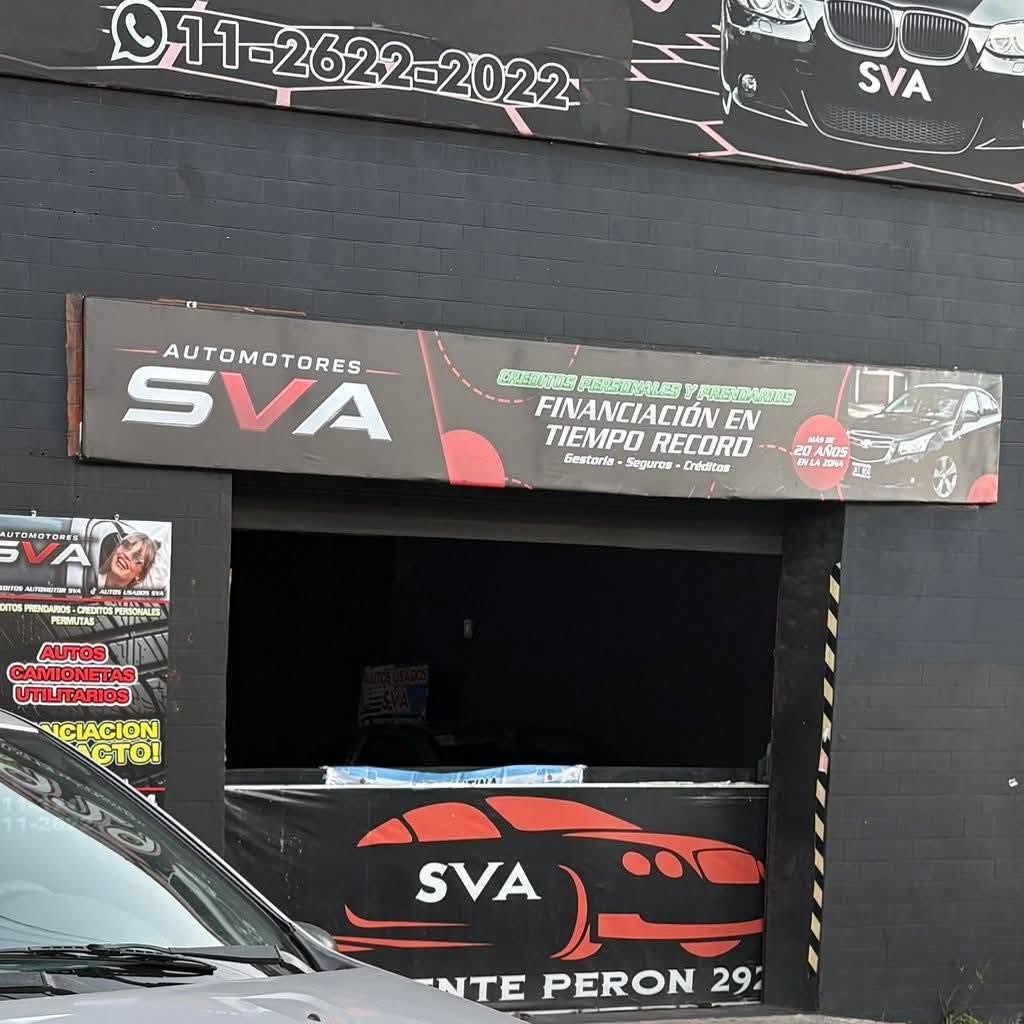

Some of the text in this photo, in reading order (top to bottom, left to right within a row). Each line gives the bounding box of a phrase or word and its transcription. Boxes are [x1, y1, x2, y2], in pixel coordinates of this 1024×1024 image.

[177, 16, 570, 111] 11-2622-2022
[858, 60, 932, 102] SVA
[162, 343, 362, 376] AUTOMOTORES
[121, 365, 393, 443] SVA
[534, 395, 761, 430] FINANCIACIÓN EN
[545, 424, 753, 457] TIEMPO RECORD
[794, 443, 848, 458] 20 AÑOS
[625, 457, 672, 471] Seguros
[683, 460, 730, 472] Créditos
[0, 531, 79, 541] AUTOMOTORES
[24, 604, 71, 615] PRENDARIOS
[77, 606, 114, 616] CREDITOS
[115, 608, 161, 617] PERSONALES
[51, 616, 95, 626] PERMUTAS
[37, 643, 109, 663] AUTOS
[8, 664, 138, 684] CAMIONETAS
[13, 685, 132, 705] UTILITARIOS
[416, 862, 541, 902] SVA
[413, 974, 526, 1002] NTE
[542, 968, 696, 999] PERON
